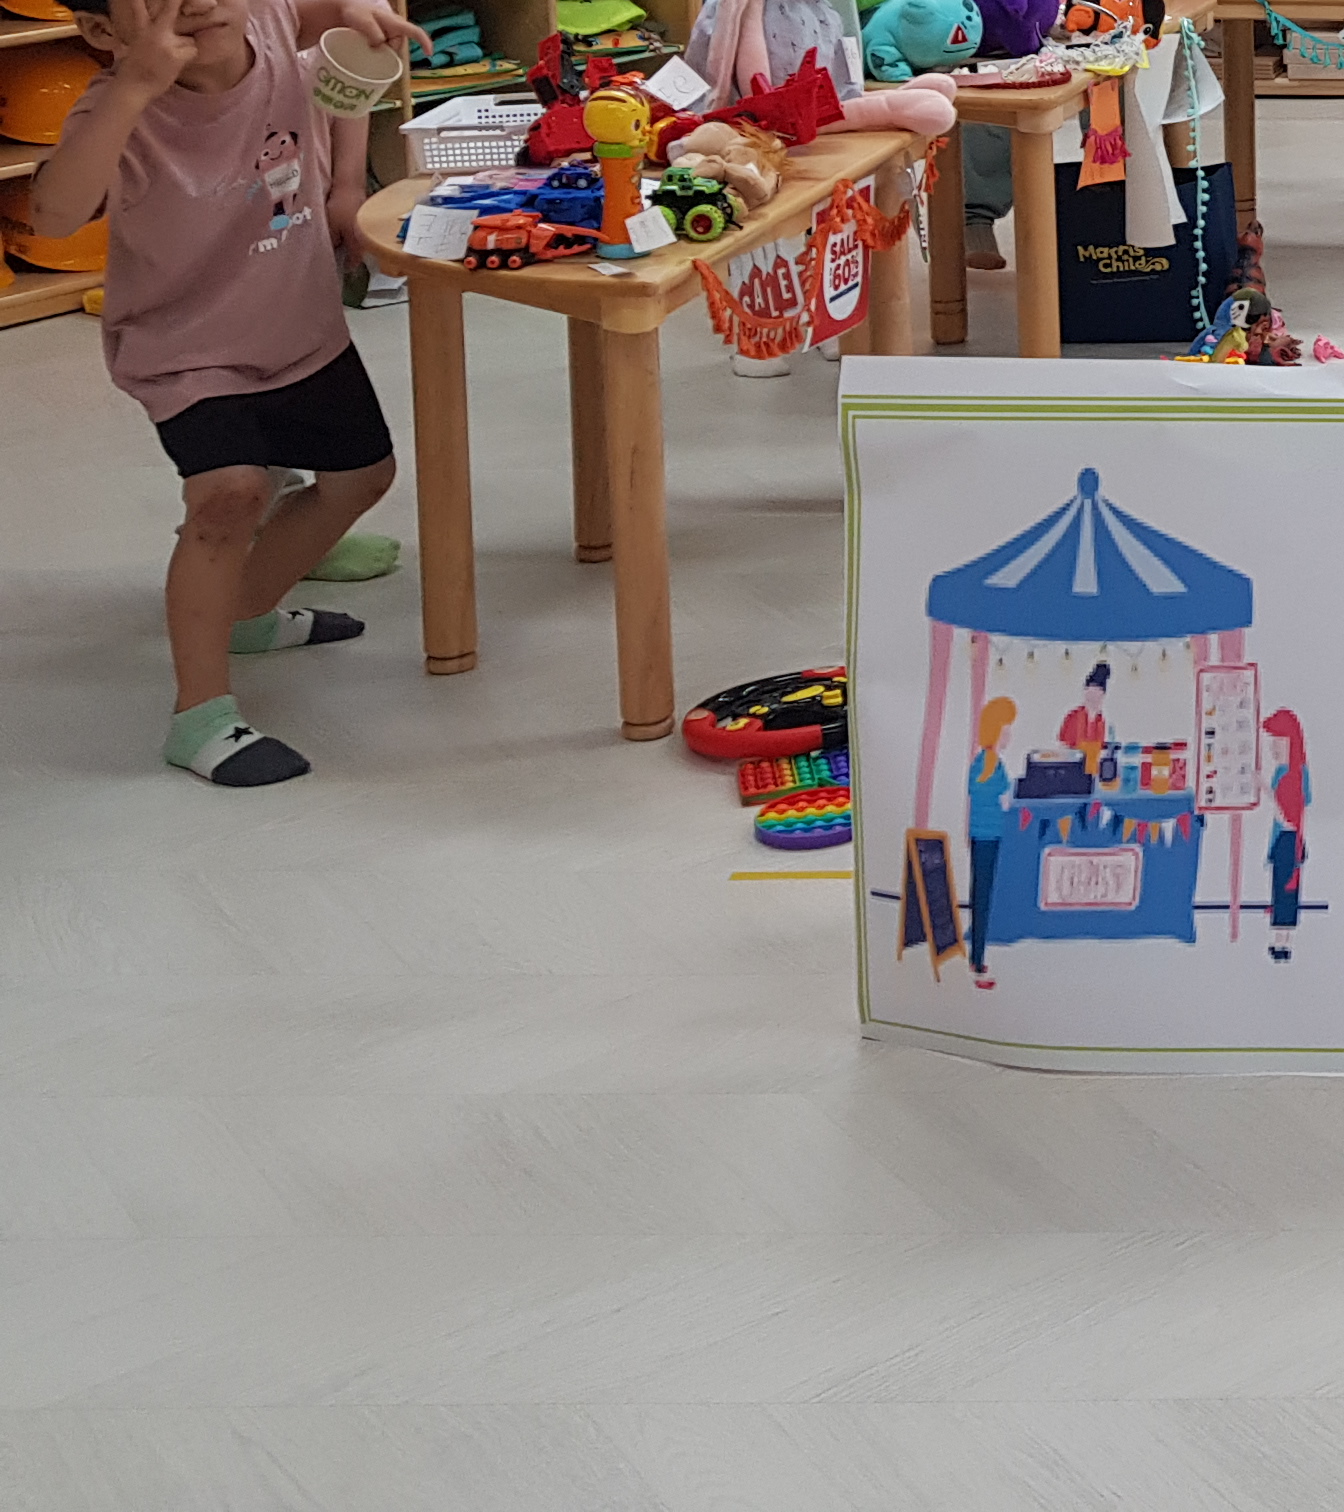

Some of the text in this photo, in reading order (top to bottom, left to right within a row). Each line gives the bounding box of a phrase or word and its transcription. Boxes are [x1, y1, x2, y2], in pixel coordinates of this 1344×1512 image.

[829, 235, 860, 264] SALE
[1098, 254, 1148, 273] Child
[742, 268, 793, 317] SALE
